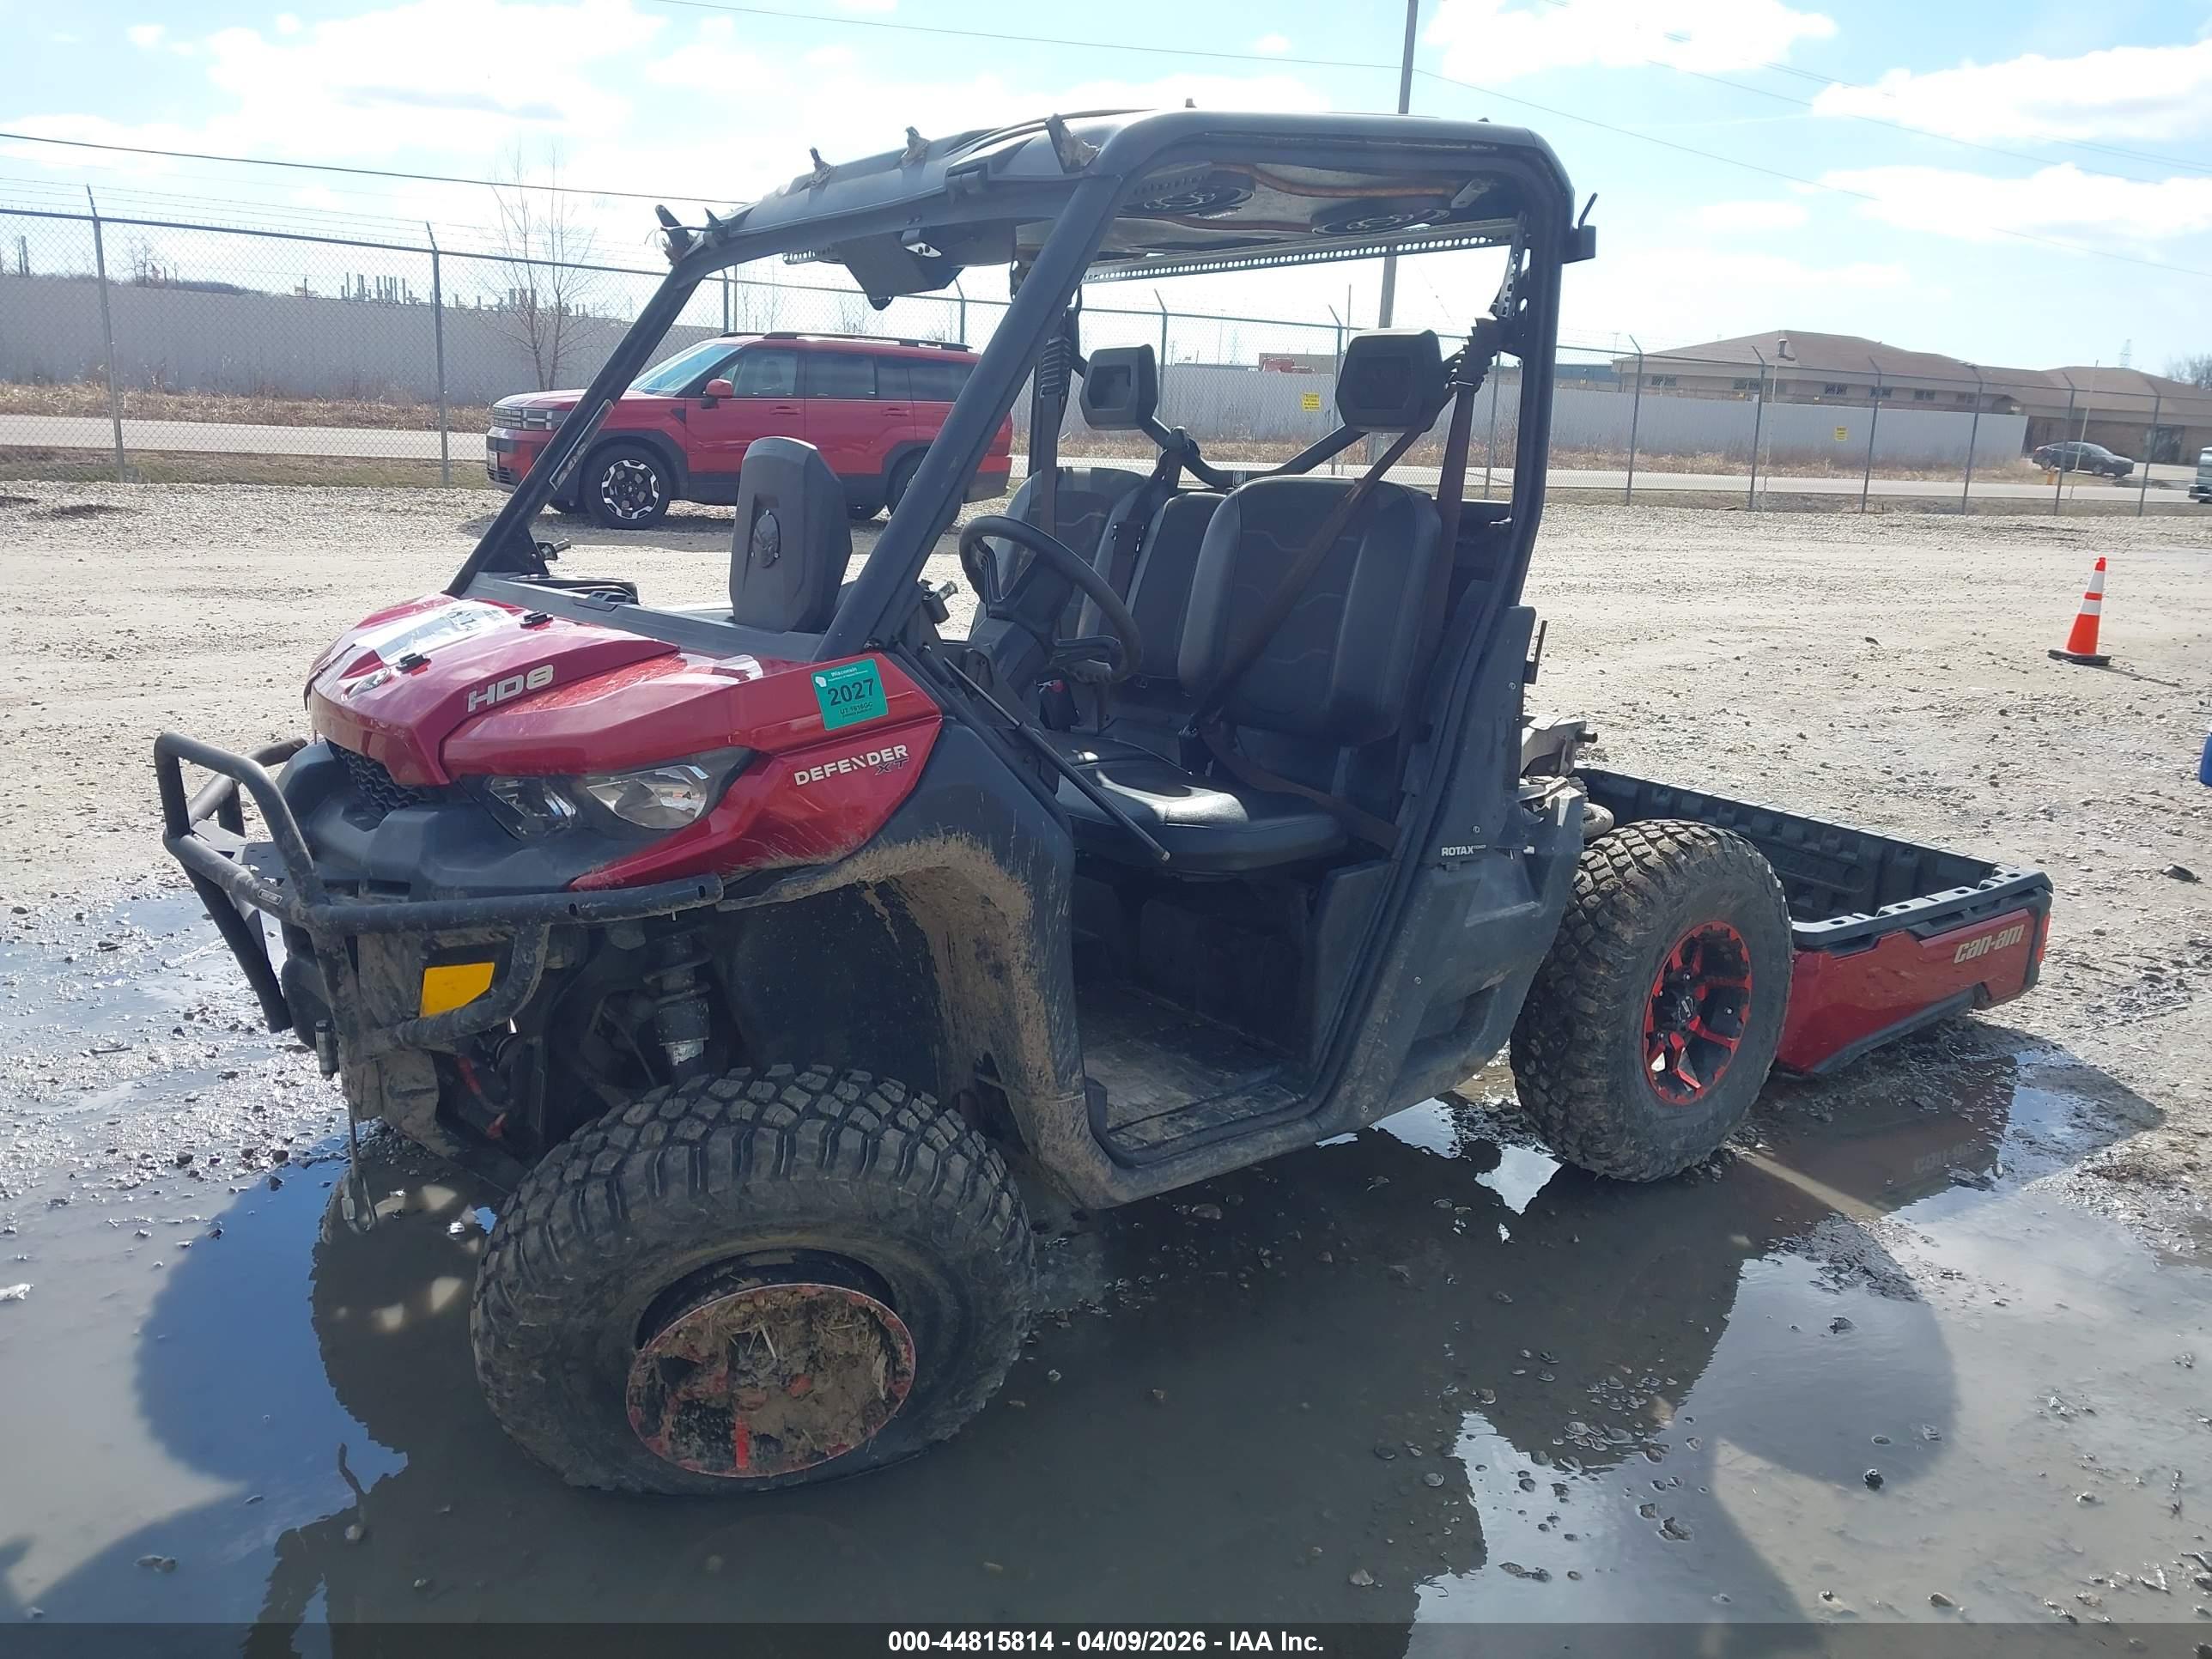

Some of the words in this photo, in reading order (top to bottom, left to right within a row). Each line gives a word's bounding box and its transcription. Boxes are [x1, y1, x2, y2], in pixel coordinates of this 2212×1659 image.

[831, 666, 858, 678] Wisconsin
[467, 665, 554, 712] HD8
[827, 678, 873, 706] 2027
[794, 744, 908, 786] DEFENDER
[875, 757, 909, 775] XT
[1442, 846, 1474, 856] ROTAX
[1954, 924, 2025, 963] can-am
